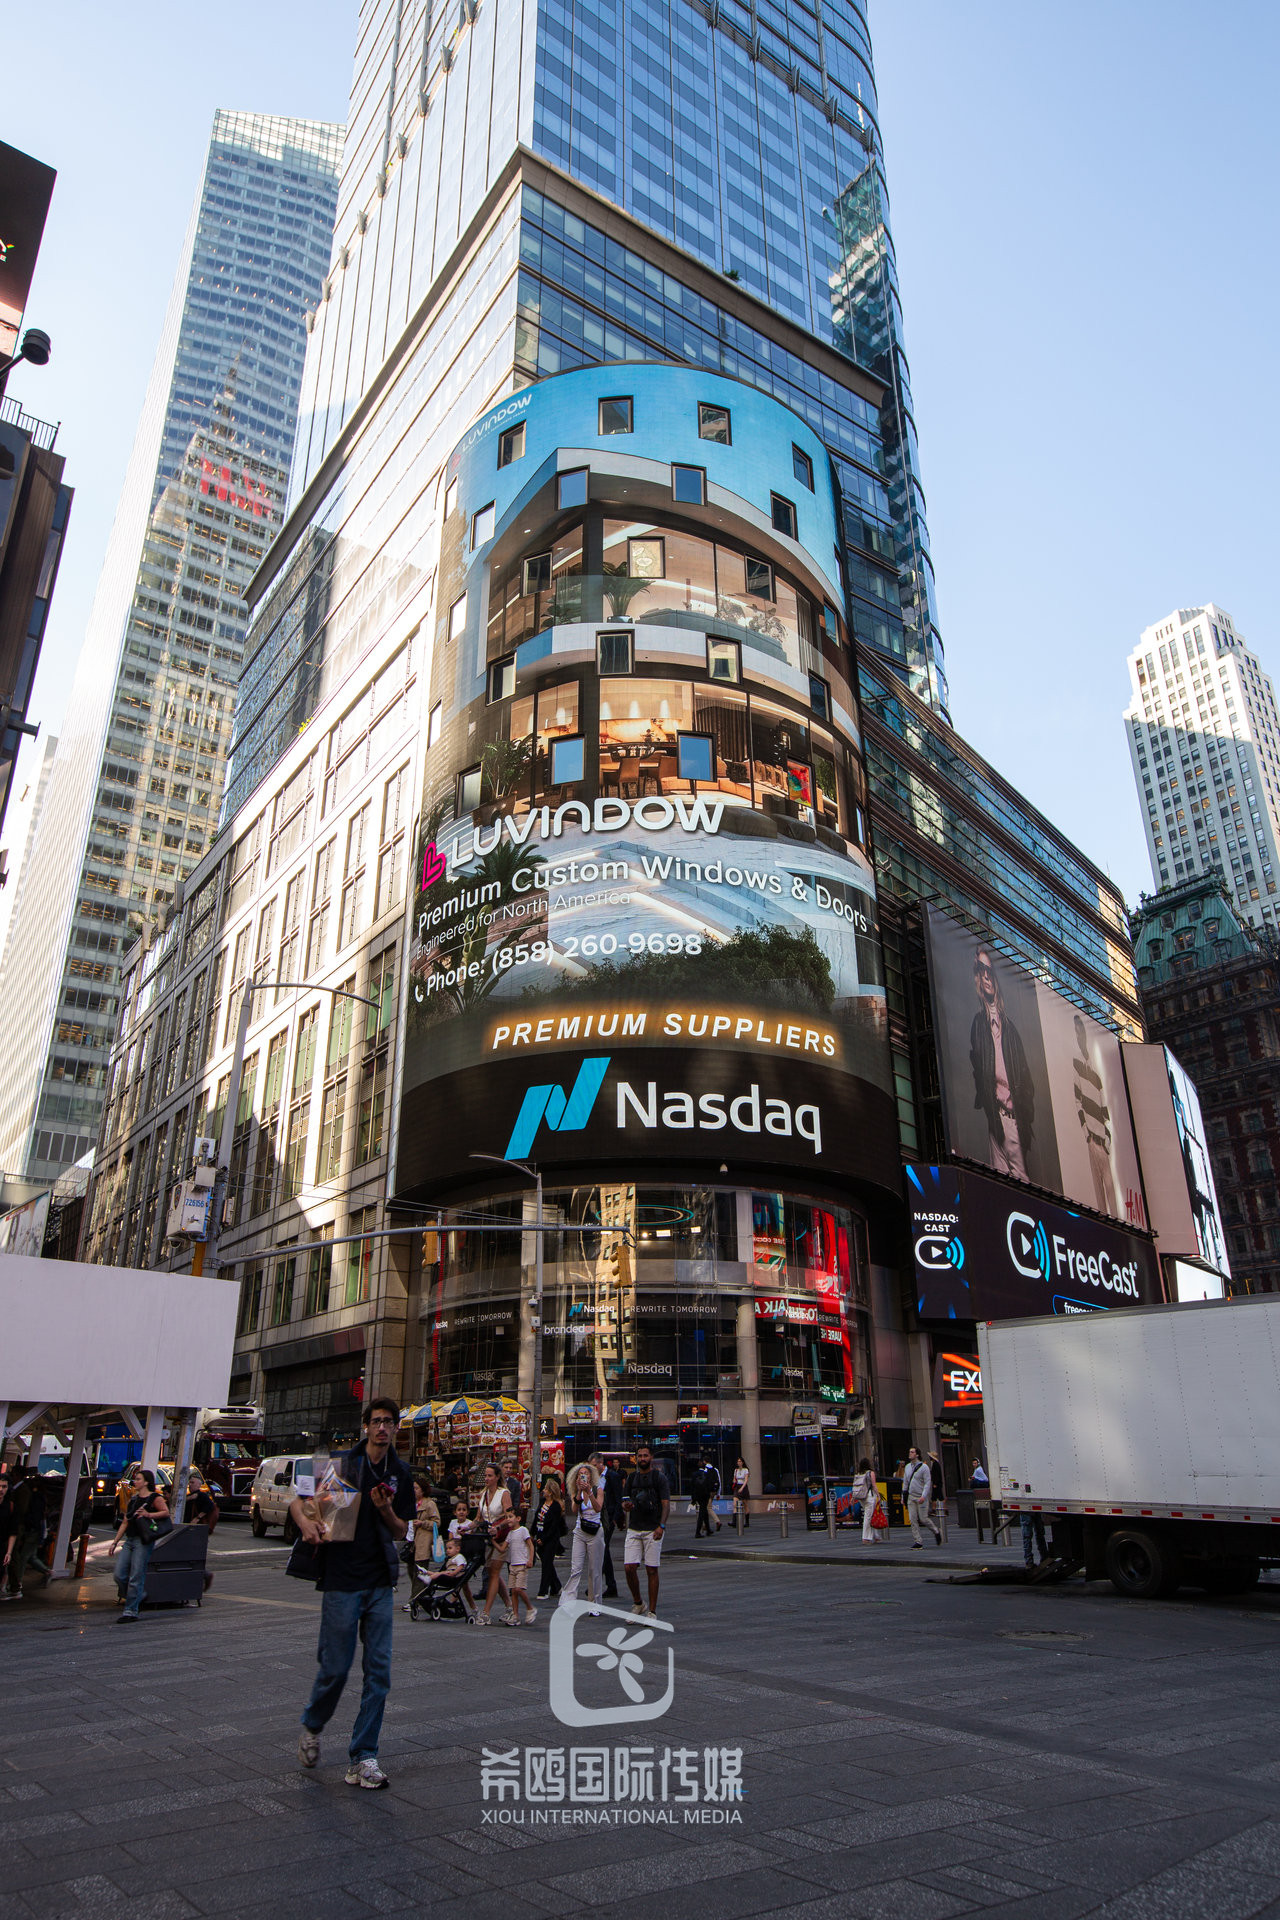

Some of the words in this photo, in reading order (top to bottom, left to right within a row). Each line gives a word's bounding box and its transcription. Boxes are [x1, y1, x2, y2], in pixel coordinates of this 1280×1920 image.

[418, 880, 501, 937] Premium
[511, 860, 629, 893] Custom
[641, 855, 782, 894] Windows
[791, 876, 809, 903] &
[816, 884, 868, 933] Doors
[416, 920, 475, 960] Engineered
[479, 910, 498, 929] for
[502, 897, 548, 920] North
[554, 889, 631, 909] America
[426, 957, 485, 997] Phone:
[492, 939, 553, 976] (858)
[563, 932, 703, 958] 260-9698
[493, 1013, 647, 1050] PREMIUM
[663, 1013, 836, 1056] SUPPLIERS
[617, 1081, 823, 1154] Nasdaq
[1125, 1187, 1145, 1228] H&M
[913, 1212, 959, 1223] NASDAQ:
[924, 1223, 951, 1233] CAST
[583, 1305, 615, 1314] Nasdaq
[630, 1305, 667, 1313] REWRITE
[671, 1305, 718, 1314] TOMORROW
[478, 1311, 513, 1323] TOMORROW
[628, 1363, 672, 1376] Nasdaq
[783, 1367, 804, 1379] Nasdaq
